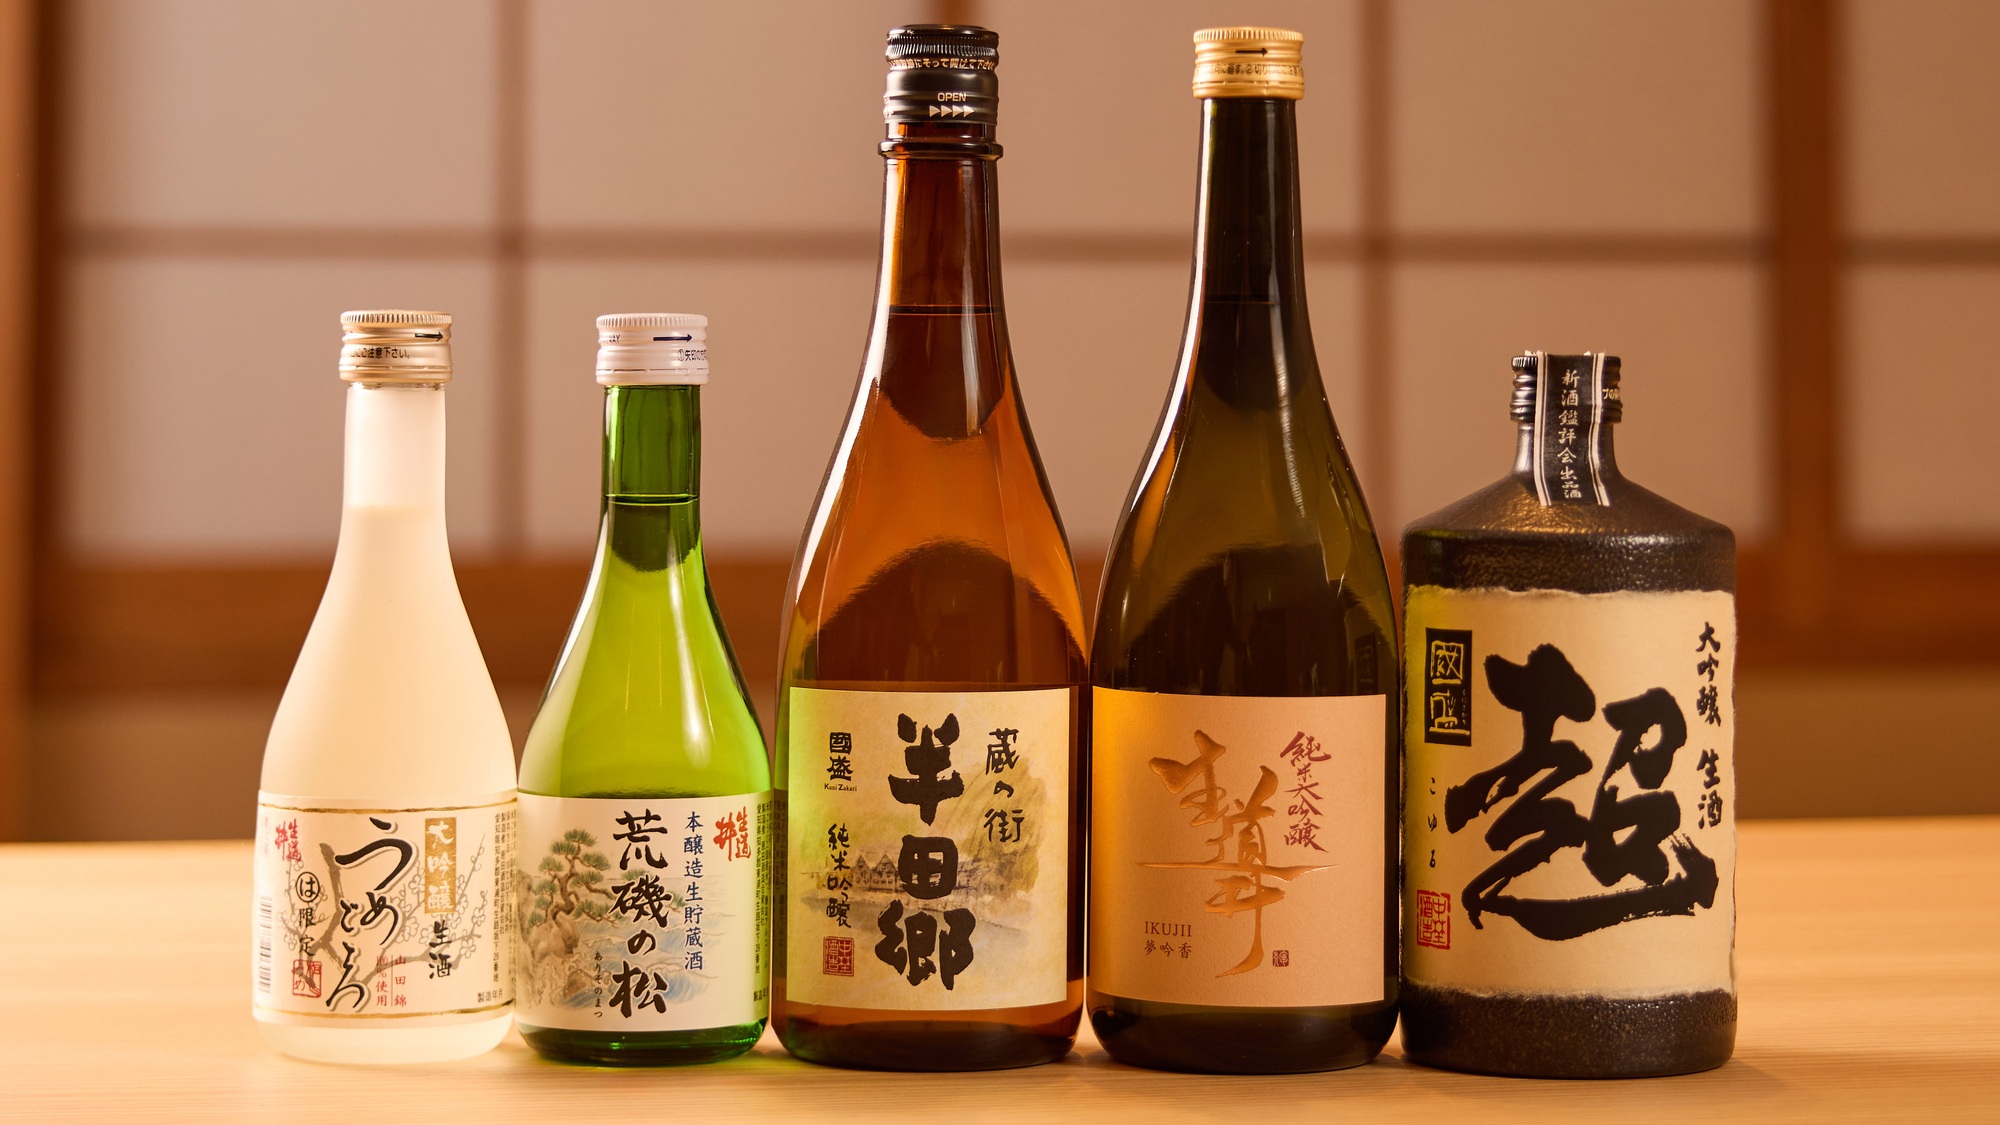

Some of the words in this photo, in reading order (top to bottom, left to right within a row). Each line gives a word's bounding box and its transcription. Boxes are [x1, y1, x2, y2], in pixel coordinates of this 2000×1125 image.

[937, 92, 967, 102] OPEN
[1557, 369, 1582, 498] 新酒鑑評会出品酒
[1696, 621, 1722, 727] 大吟醸
[983, 728, 1024, 842] 蔵の街
[1280, 731, 1331, 853] 純米大吟醸
[1445, 643, 1719, 941] 超
[1696, 749, 1723, 829] 生酒
[427, 821, 454, 911] 大吟醸
[683, 811, 704, 970] 本醸造生貯蔵酒
[826, 823, 852, 928] 純米吟醸
[875, 713, 976, 990] 半田郷
[428, 920, 451, 979] 生酒
[608, 808, 674, 1018] 荒磯の松
[1144, 921, 1192, 937] IKUJII
[1144, 939, 1192, 959] 夢吟香
[394, 954, 408, 1007] 山田錦
[594, 951, 603, 1018] ありそのまつ
